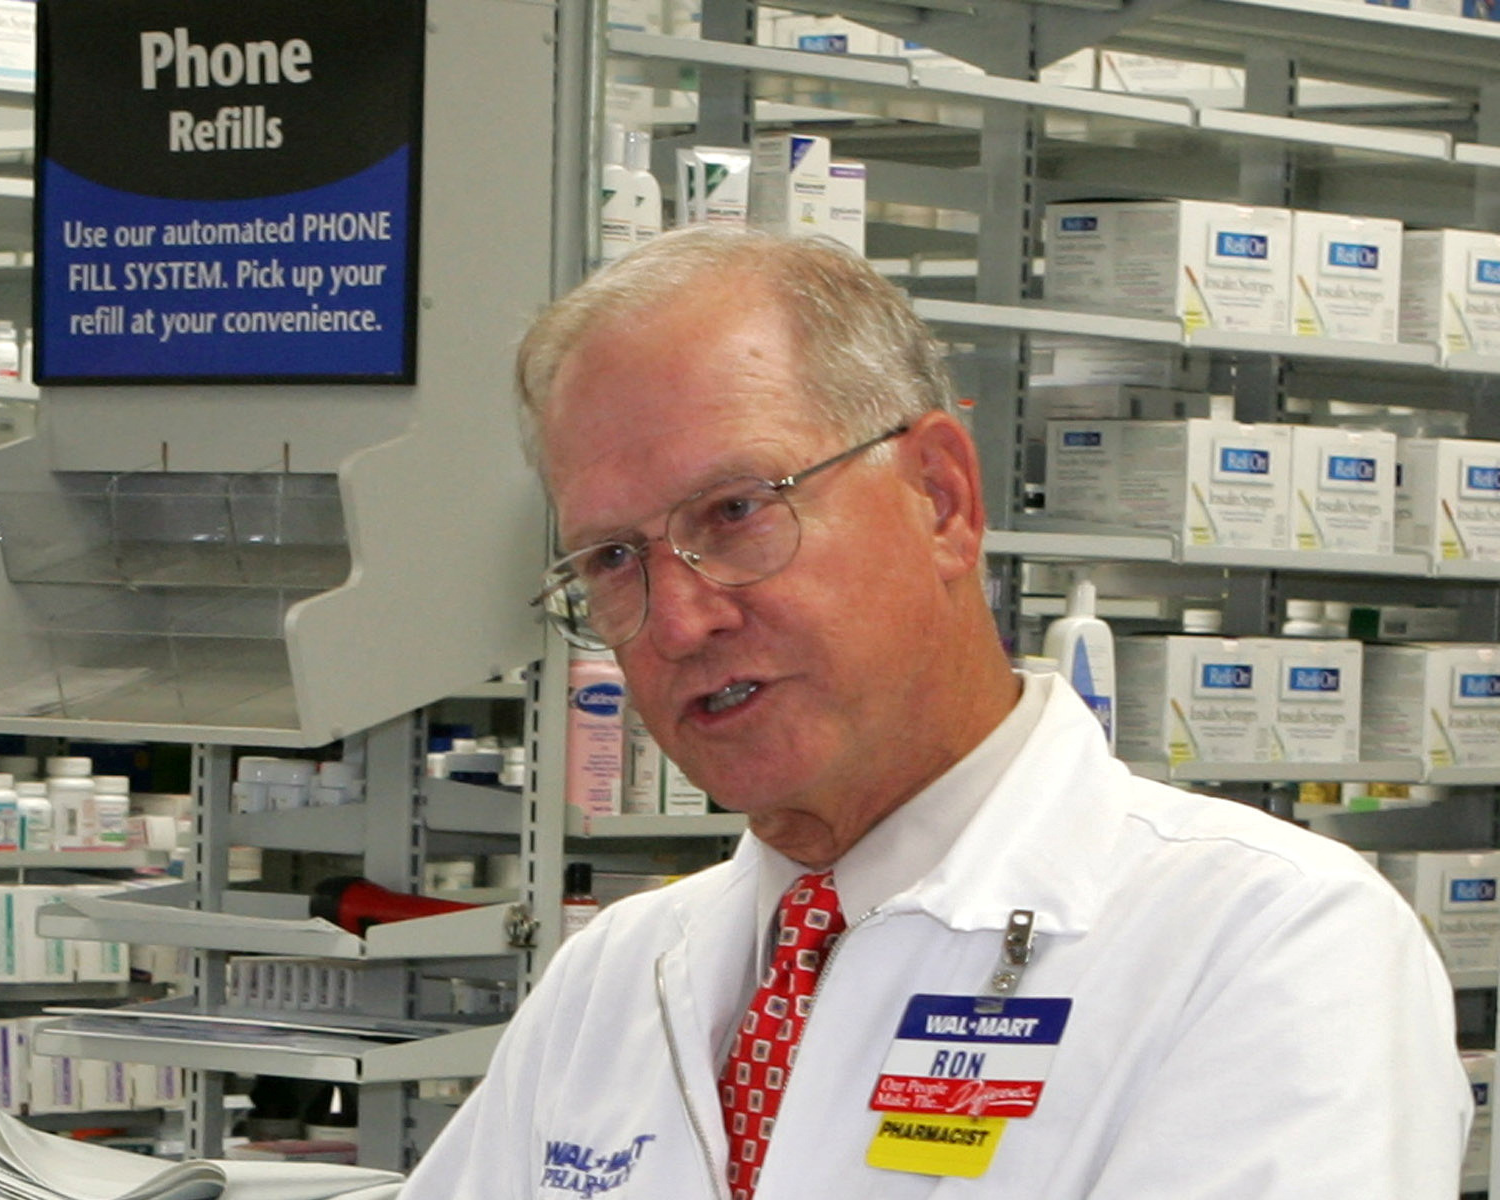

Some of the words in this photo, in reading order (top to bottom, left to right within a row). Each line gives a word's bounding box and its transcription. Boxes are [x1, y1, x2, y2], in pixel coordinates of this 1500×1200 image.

[140, 27, 313, 90] Phone
[168, 105, 284, 152] Refills
[63, 221, 107, 248] Use
[114, 226, 156, 247] our
[162, 213, 295, 246] automated
[302, 211, 392, 242] PHONE
[68, 264, 116, 291] FILL
[124, 261, 229, 290] SYSTEM.
[237, 259, 285, 289] Pick
[292, 266, 323, 296] up
[329, 264, 387, 296] your
[70, 306, 124, 335] refill
[130, 310, 155, 334] at
[161, 313, 217, 343] your
[222, 303, 382, 334] convenience.
[930, 1049, 987, 1079] RON
[874, 1091, 911, 1108] Make
[880, 1077, 906, 1094] Our
[907, 1079, 950, 1098] People
[878, 1121, 990, 1146] PHARMACIST
